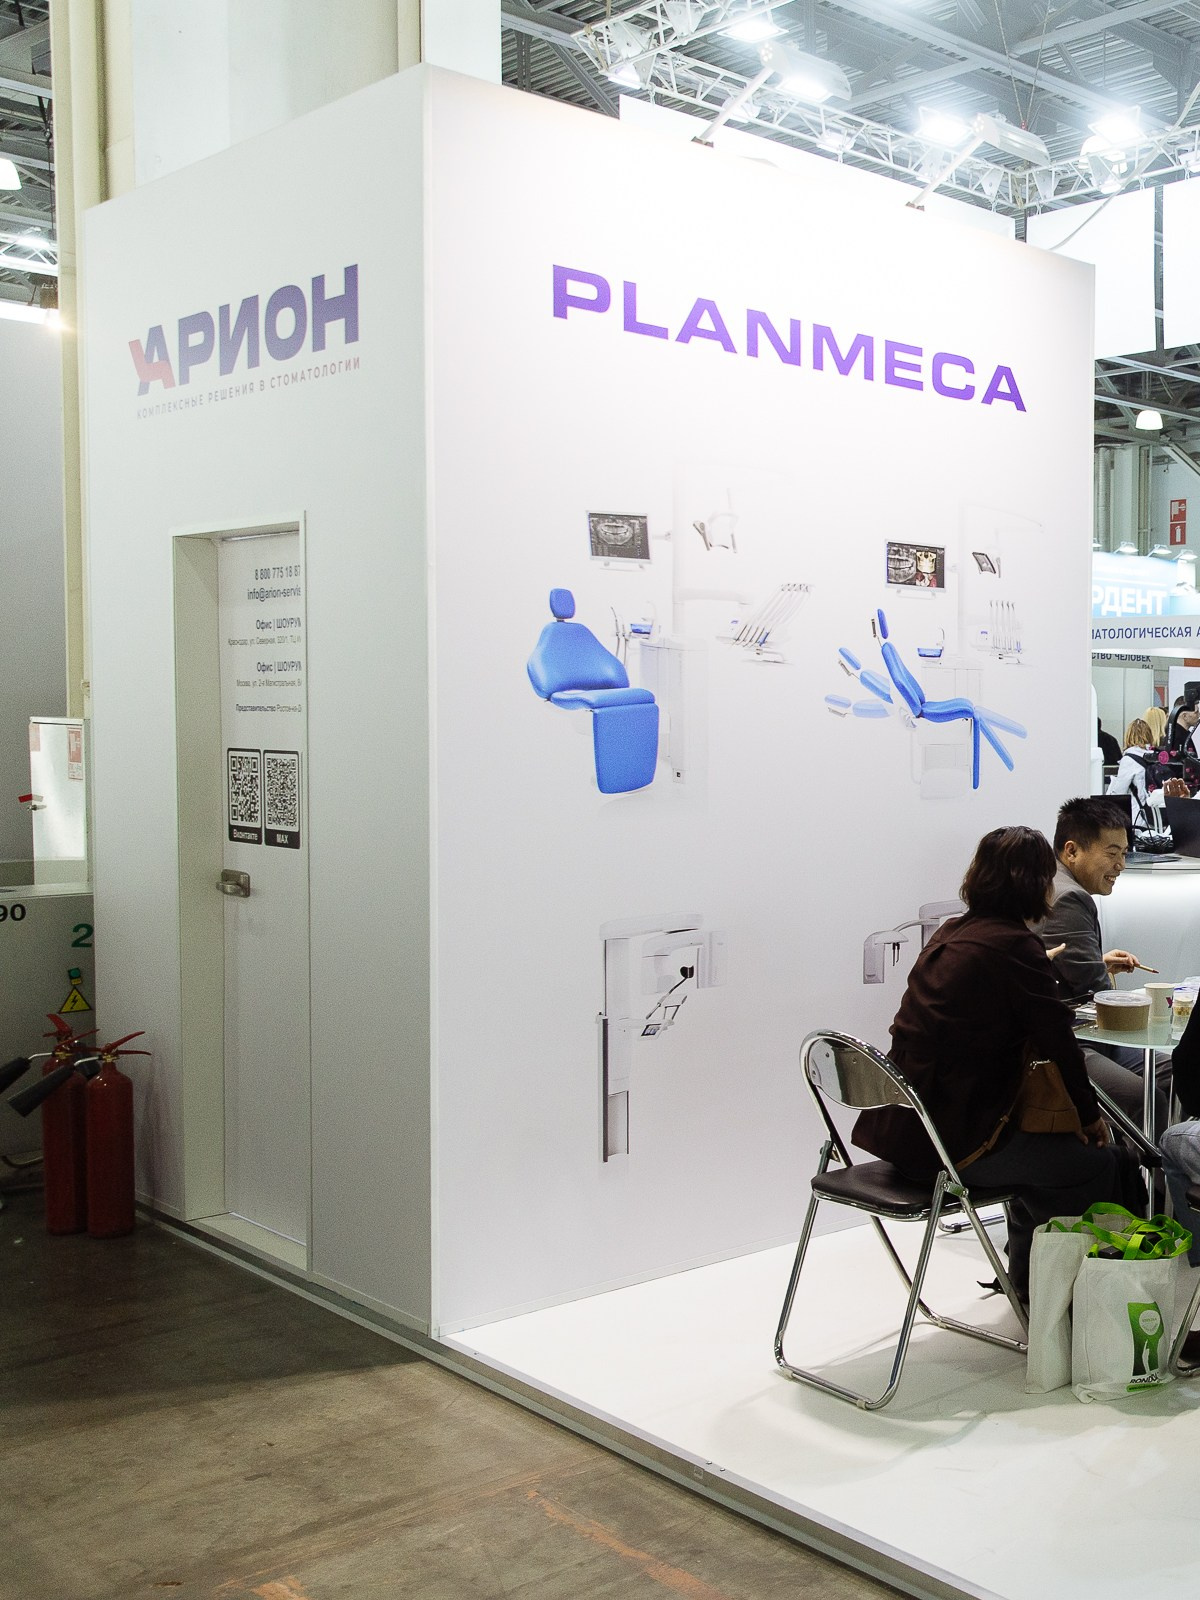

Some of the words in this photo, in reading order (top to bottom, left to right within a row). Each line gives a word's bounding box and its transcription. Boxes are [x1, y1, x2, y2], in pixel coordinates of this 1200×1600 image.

[128, 264, 359, 396] АРИОН
[552, 264, 1027, 413] PLANMECA
[137, 394, 204, 420] КОМПЛЕКСНЫЕ
[208, 381, 255, 404] РЕШЕНИЯ
[259, 380, 265, 392] В
[270, 357, 361, 389] СТОМАТОЛОГИИ
[272, 566, 283, 578] 775
[256, 619, 272, 632] Офис
[257, 661, 273, 674] Офис
